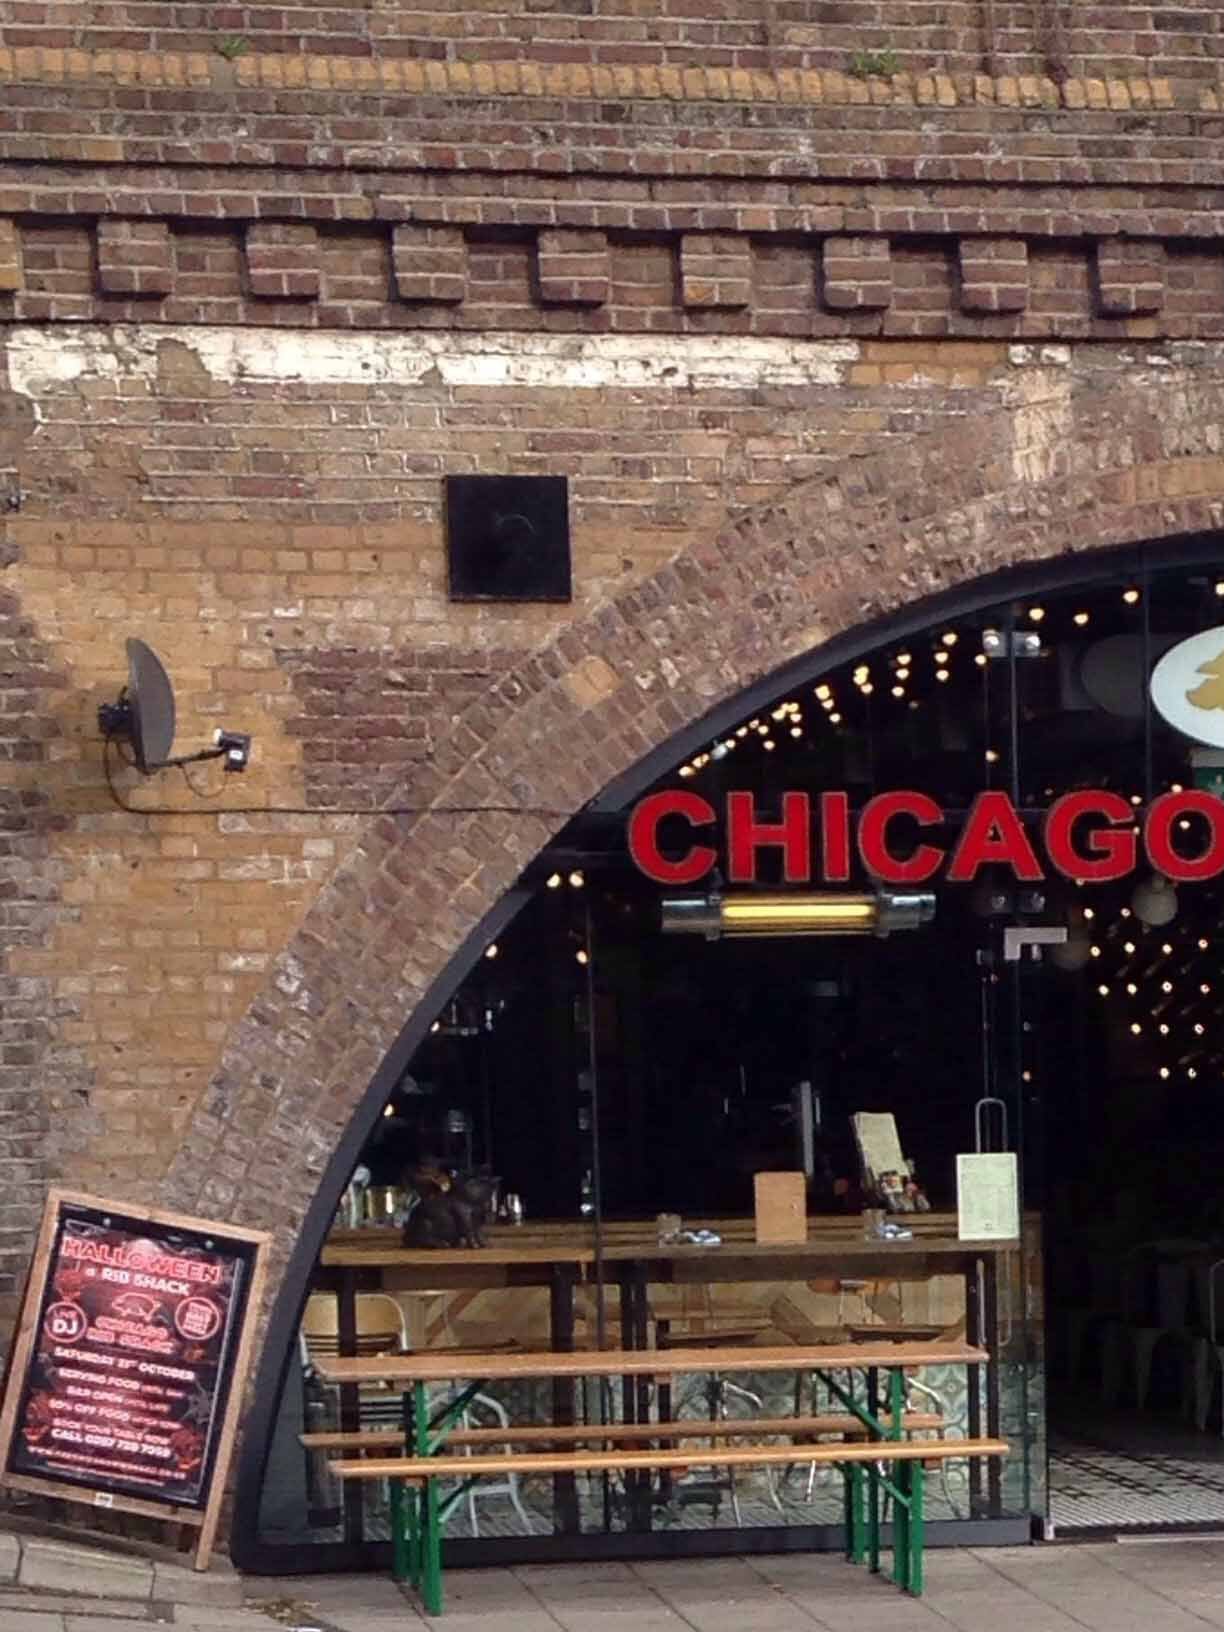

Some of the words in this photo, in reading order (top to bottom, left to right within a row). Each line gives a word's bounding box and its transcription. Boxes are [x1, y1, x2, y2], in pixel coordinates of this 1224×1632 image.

[61, 1236, 220, 1283] HALLOWEEN
[133, 1273, 190, 1295] SHACK
[53, 1320, 77, 1334] DJ
